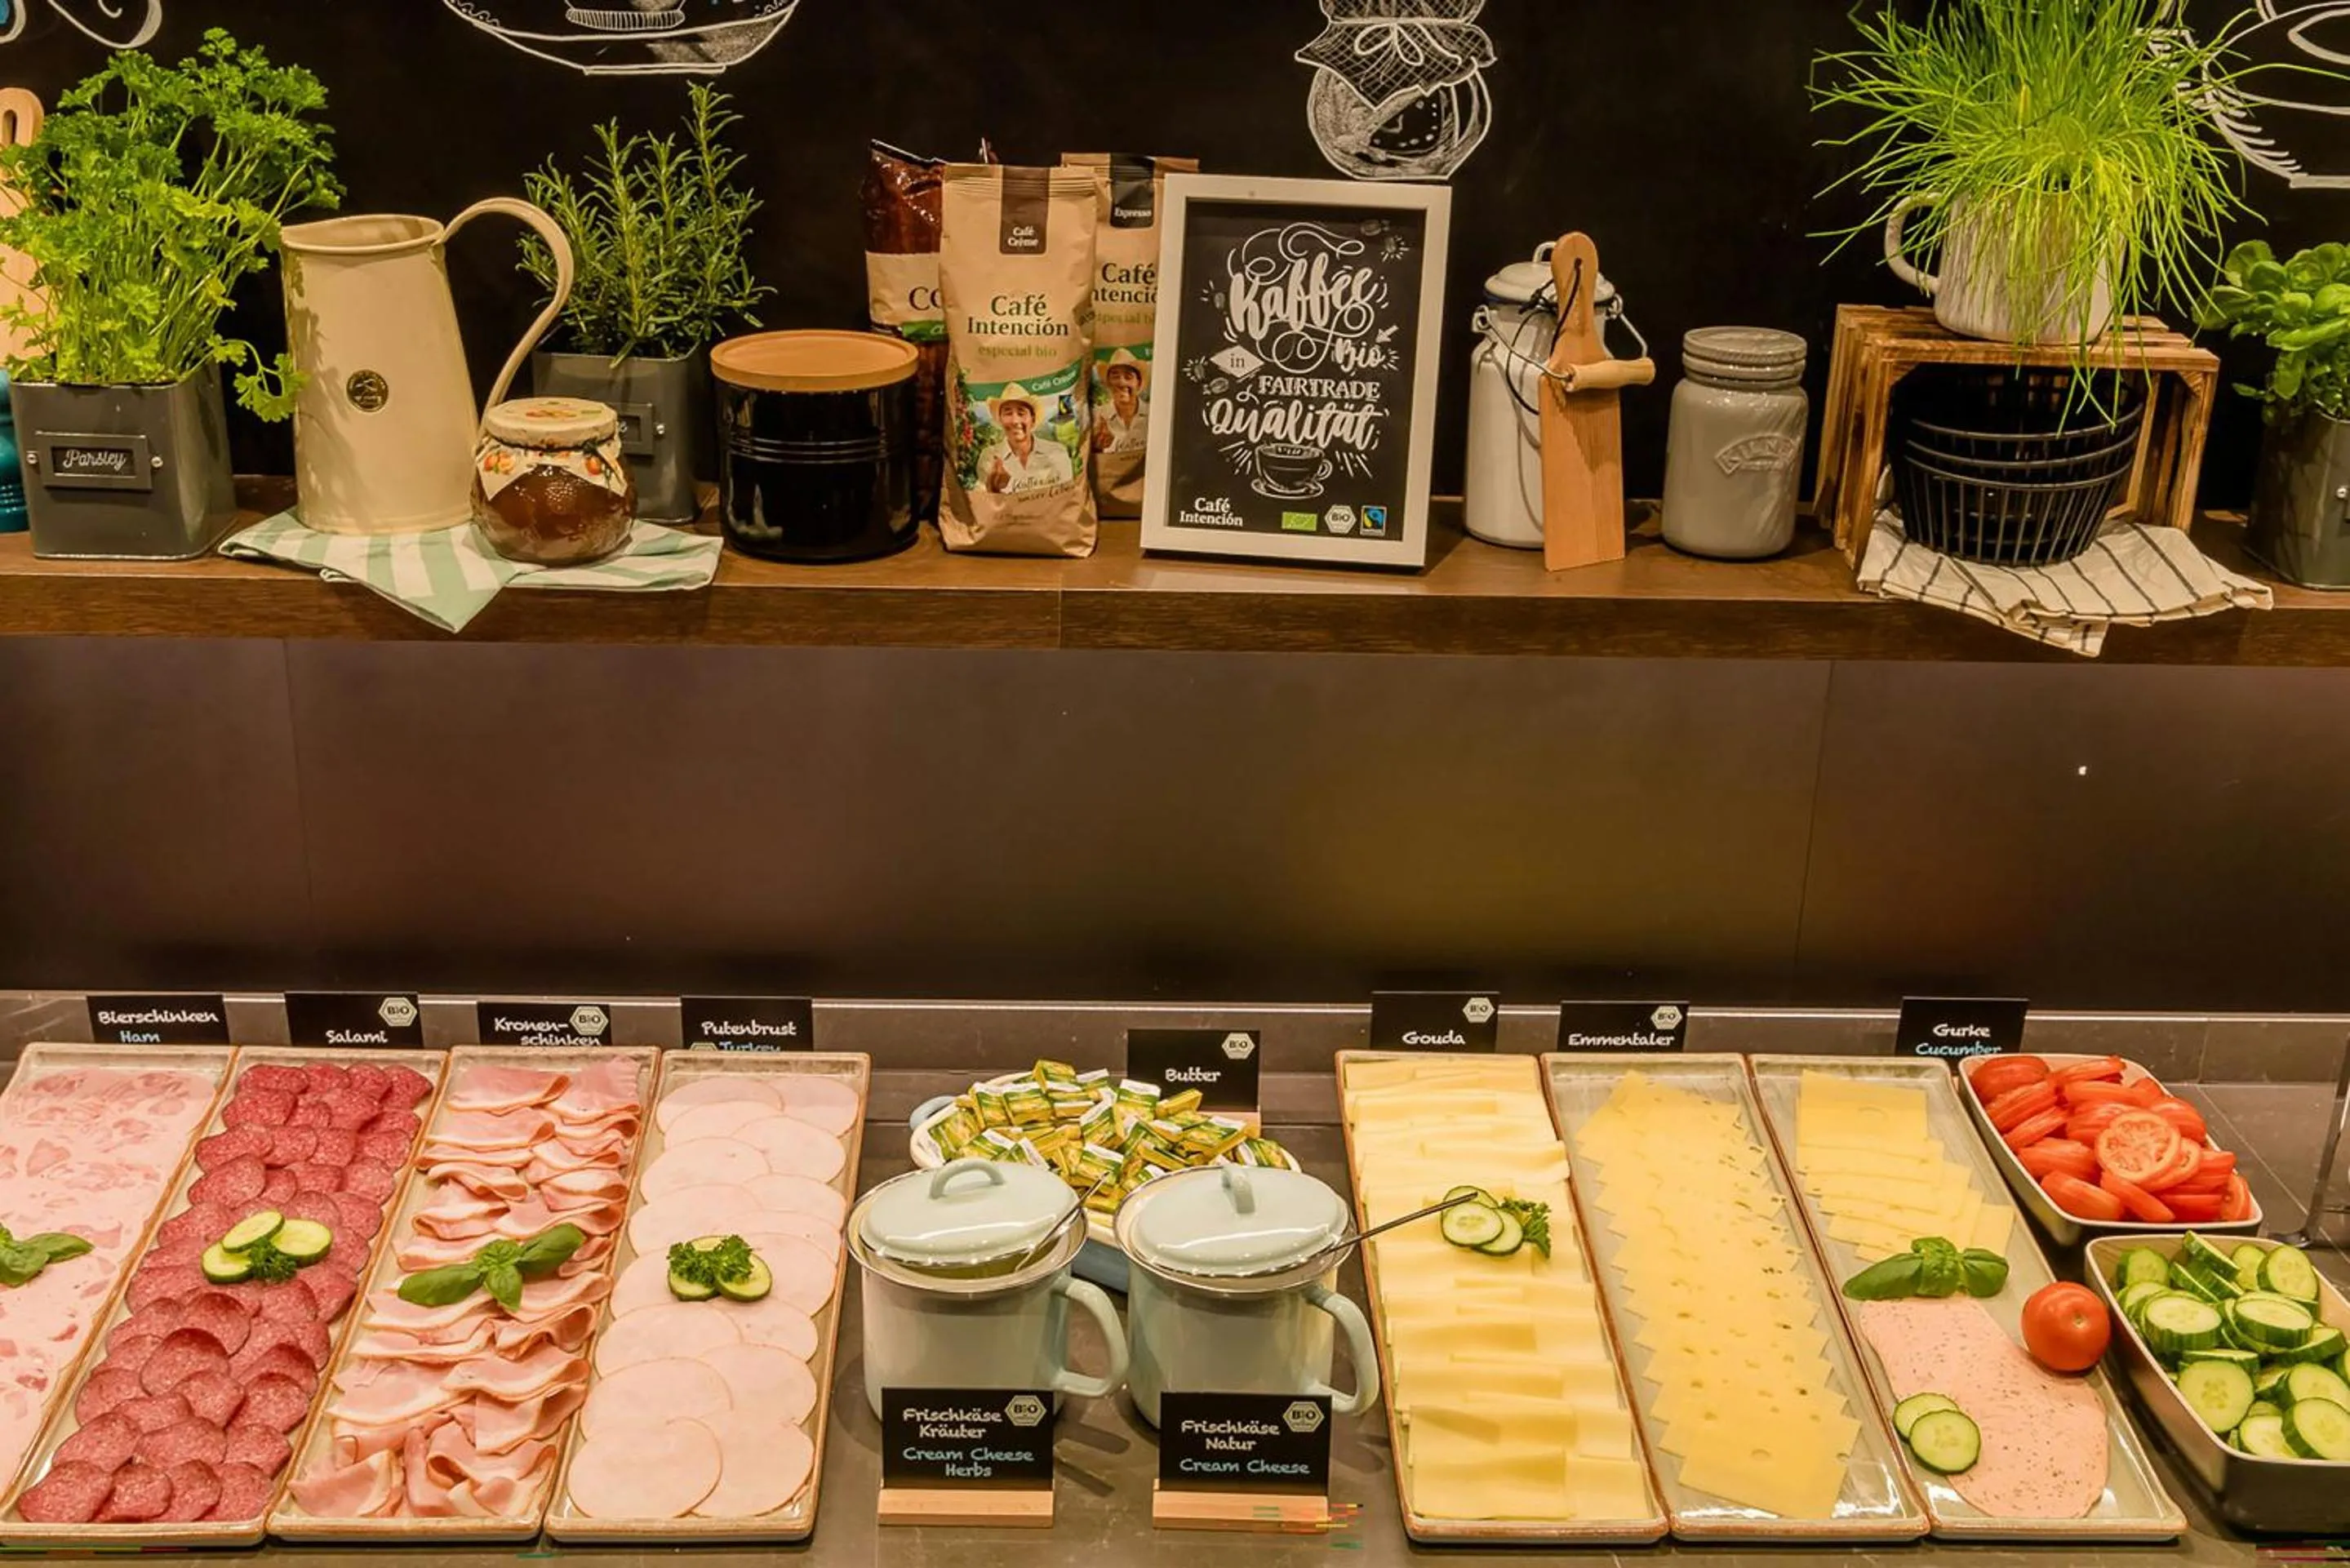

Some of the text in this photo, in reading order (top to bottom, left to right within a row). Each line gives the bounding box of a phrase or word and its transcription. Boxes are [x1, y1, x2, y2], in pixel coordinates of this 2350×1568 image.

[1012, 224, 1035, 237] Café
[1101, 261, 1155, 285] Café
[1091, 286, 1157, 304] ntenci
[1227, 247, 1378, 341] Kaffee
[990, 293, 1047, 317] Café
[967, 316, 1069, 336] Intención
[978, 344, 1033, 358] especial
[1334, 335, 1386, 372] Bio
[1228, 352, 1246, 368] in
[1257, 375, 1381, 402] FAIRTRADE
[1210, 398, 1384, 451] Qualität
[62, 449, 127, 472] Parsley
[1193, 496, 1232, 514] Café
[1179, 509, 1243, 527] Intención
[98, 1009, 220, 1024] Bierschinken
[494, 1016, 569, 1032] Kronen-
[701, 1019, 797, 1036] Putenbrust
[1932, 1023, 1991, 1037] Gurke
[119, 1029, 162, 1043] Ham
[325, 1028, 389, 1044] Salami
[520, 1033, 602, 1046] schinken
[1401, 1029, 1467, 1046] Gouda
[1567, 1032, 1675, 1046] Emmentaler
[1915, 1041, 2002, 1055] Cucumber
[1164, 1067, 1222, 1083] Butter
[902, 1406, 1003, 1424] Frischkäse
[918, 1423, 987, 1439] Kräuter
[1180, 1419, 1281, 1436] Frischkäse
[1205, 1436, 1257, 1451] Natur
[902, 1446, 1035, 1462] Cream Cheese
[944, 1462, 993, 1478] Herbs
[1179, 1457, 1311, 1475] Cream Cheese
